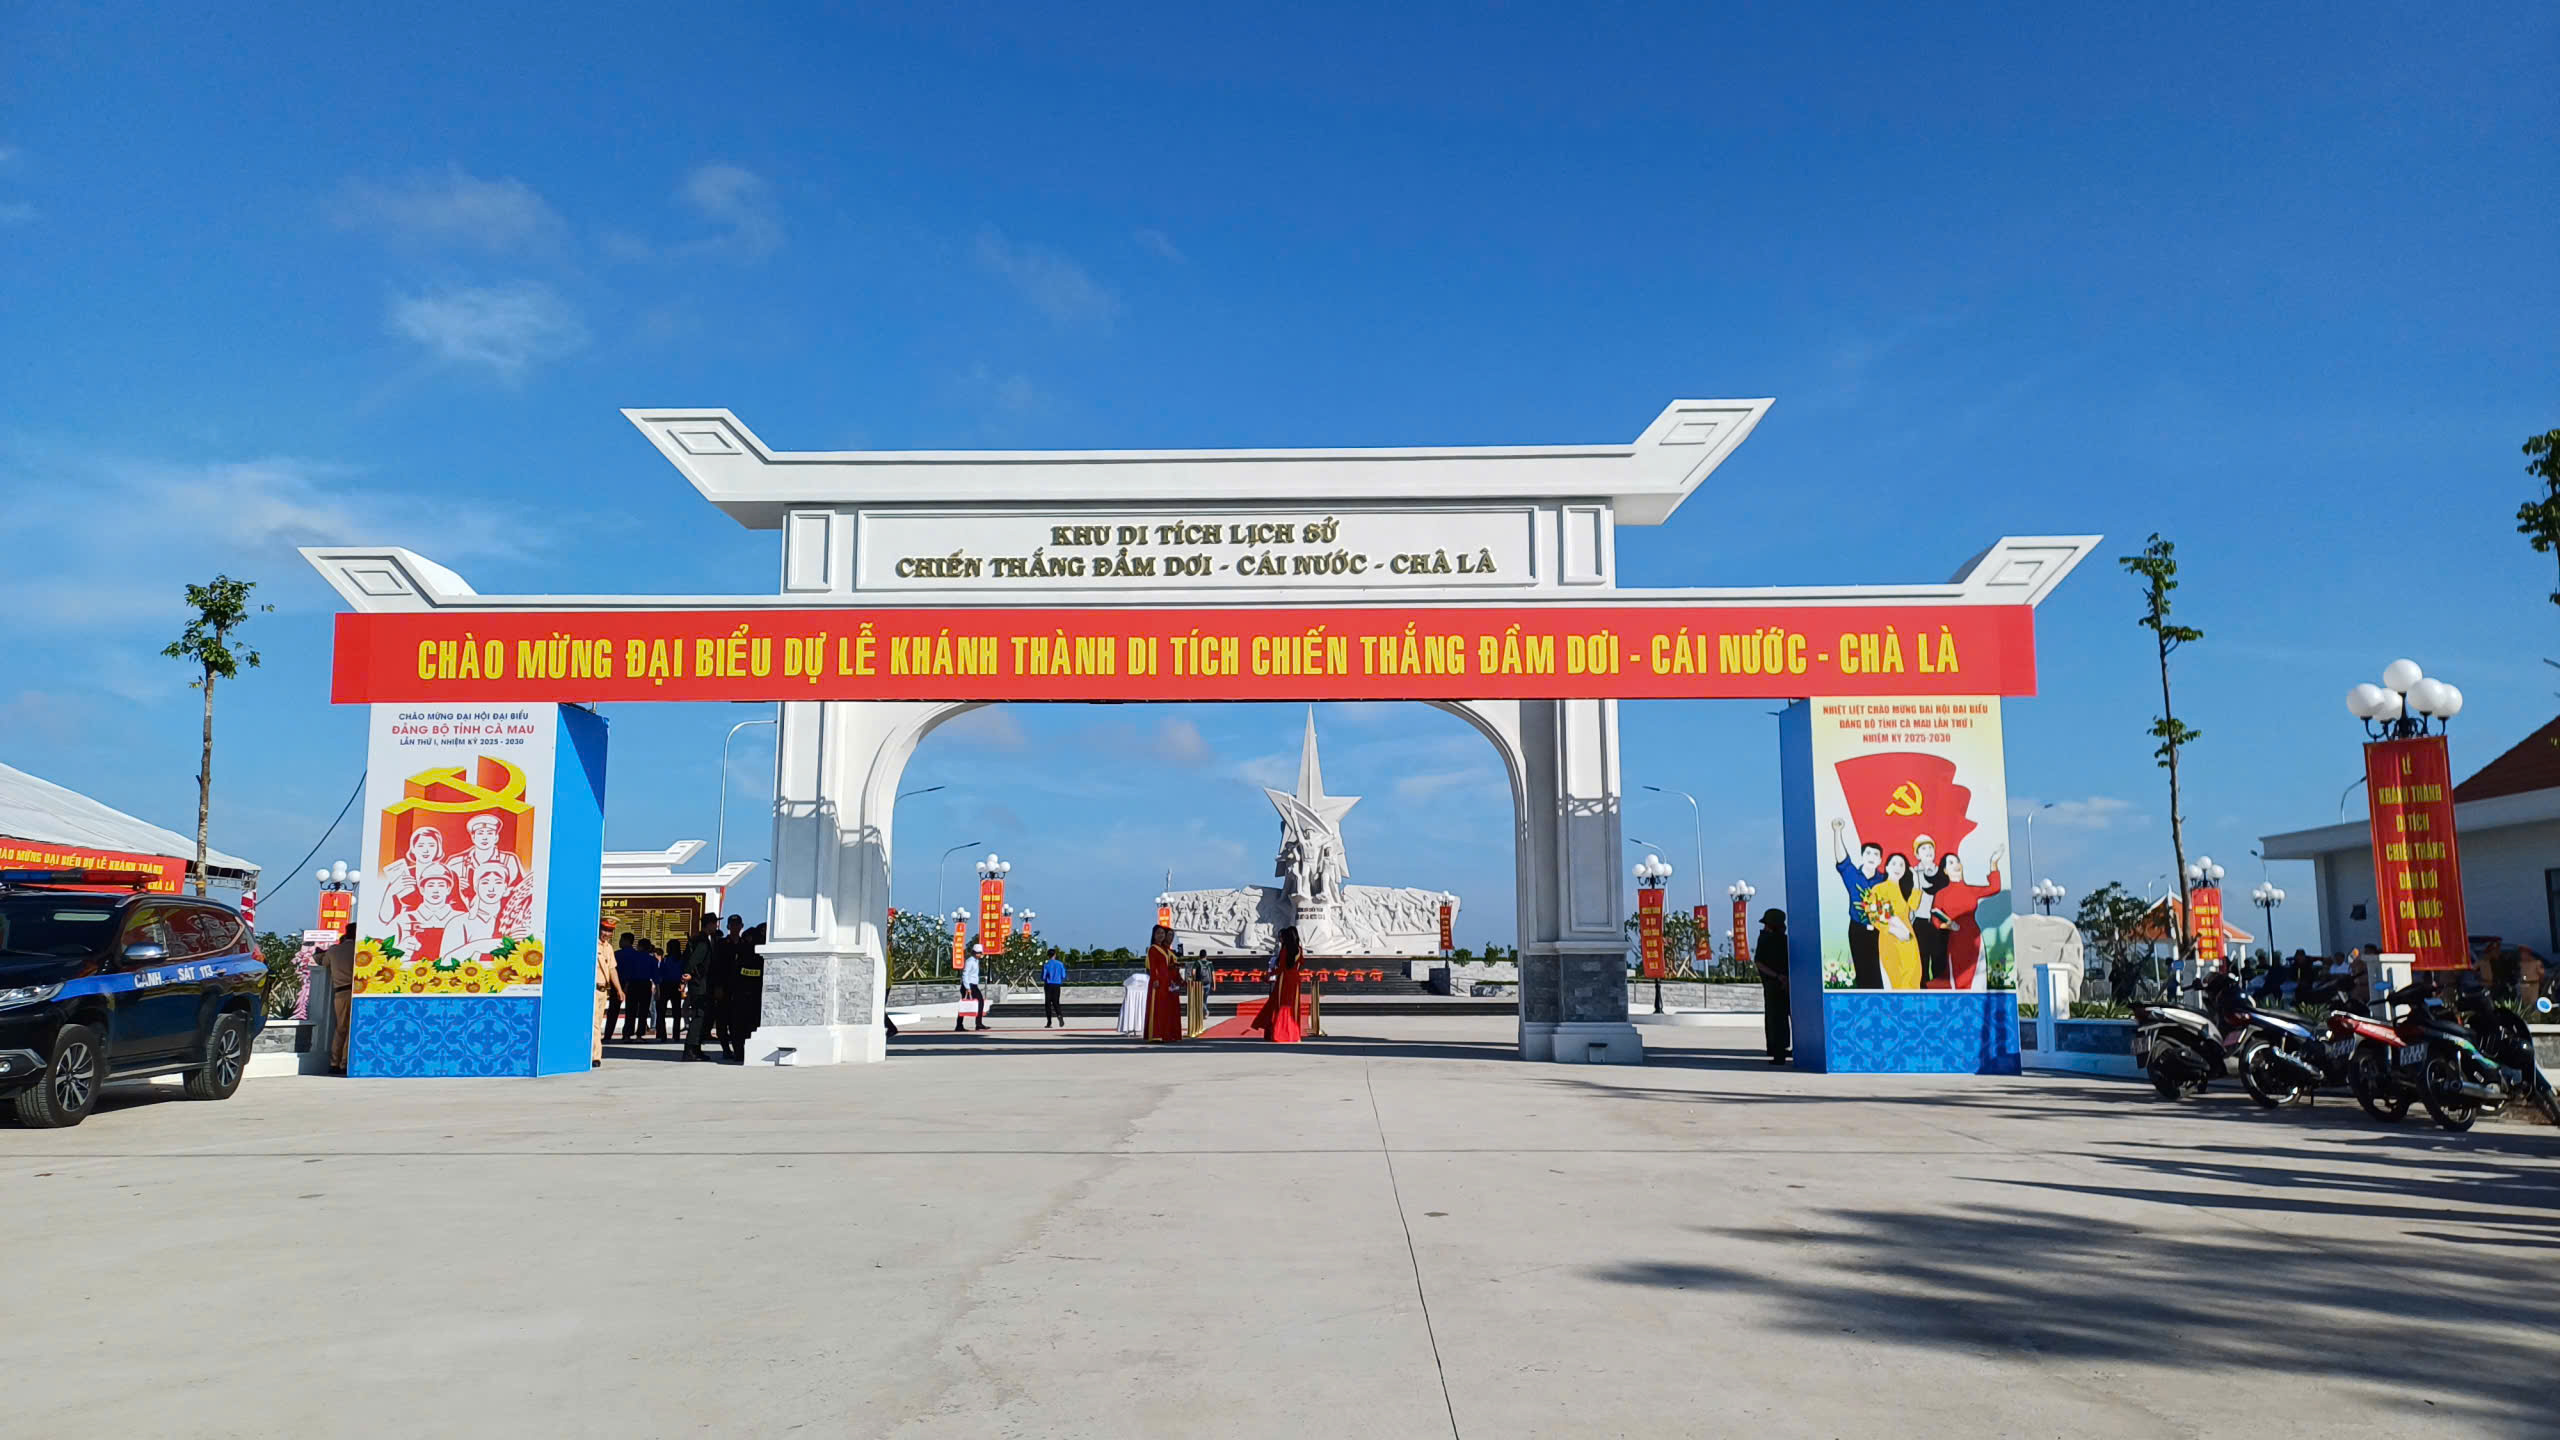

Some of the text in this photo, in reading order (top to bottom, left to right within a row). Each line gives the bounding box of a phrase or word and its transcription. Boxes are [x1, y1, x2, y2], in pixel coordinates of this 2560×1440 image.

[1051, 517, 1340, 548] KHU DI TÍCH LỊCH SỬ
[896, 549, 983, 577] CHIẾN
[989, 547, 1085, 577] THẮNG
[1092, 547, 1156, 577] ĐẦM
[1164, 553, 1213, 576] DƠI
[1237, 550, 1287, 575] CÁI
[1293, 549, 1367, 575] NƯỚC
[419, 622, 1959, 685] CHÀO MỪNG ĐẠI BIỂU DỰ LỄ KHÁNH THÀNH DI TÍCH CHIẾN THẮNG ĐẦM DƠI - CÁI NƯỚC - CHÀ LÀ
[399, 709, 529, 722] CHÀO MỪNG ĐẠI HỘI ĐẠI BIỂU
[1914, 719, 1931, 729] MAU
[392, 722, 535, 737] ĐẢNG BỘ TỈNH CÀ MAU
[400, 736, 415, 746] LẦN
[417, 737, 433, 746] THỨ
[441, 737, 466, 748] NHIỆM
[2408, 811, 2430, 832] TÍCH
[177, 964, 196, 981] SÁT
[199, 964, 215, 979] 113
